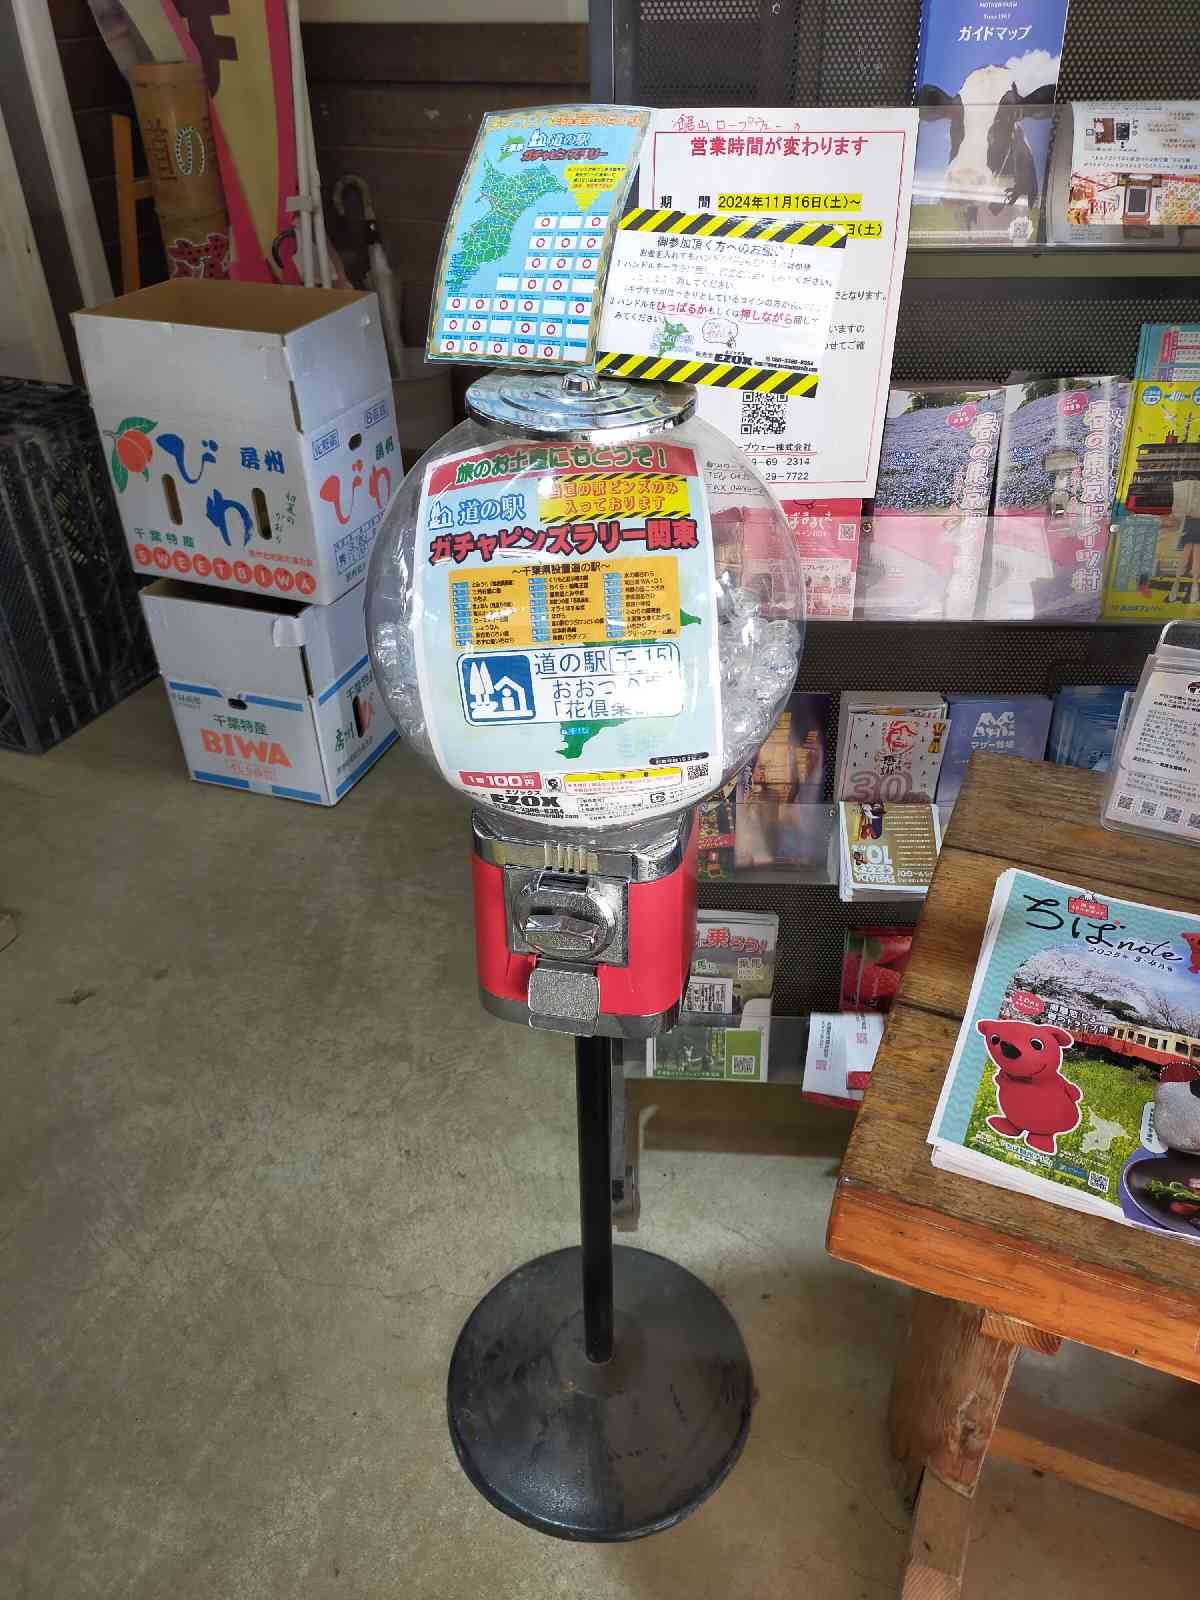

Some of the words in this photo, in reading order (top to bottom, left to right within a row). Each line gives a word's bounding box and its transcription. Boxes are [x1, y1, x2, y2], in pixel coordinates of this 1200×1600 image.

[957, 24, 1032, 42] ガイドマップ
[690, 136, 869, 157] 営業時間が変わります
[239, 446, 286, 475] 房州
[155, 432, 254, 547] びわ
[458, 493, 527, 526] 道の駅
[564, 498, 666, 515] 入っております
[428, 517, 700, 566] ガチャピンズラリー関東
[199, 728, 293, 769] BIWA
